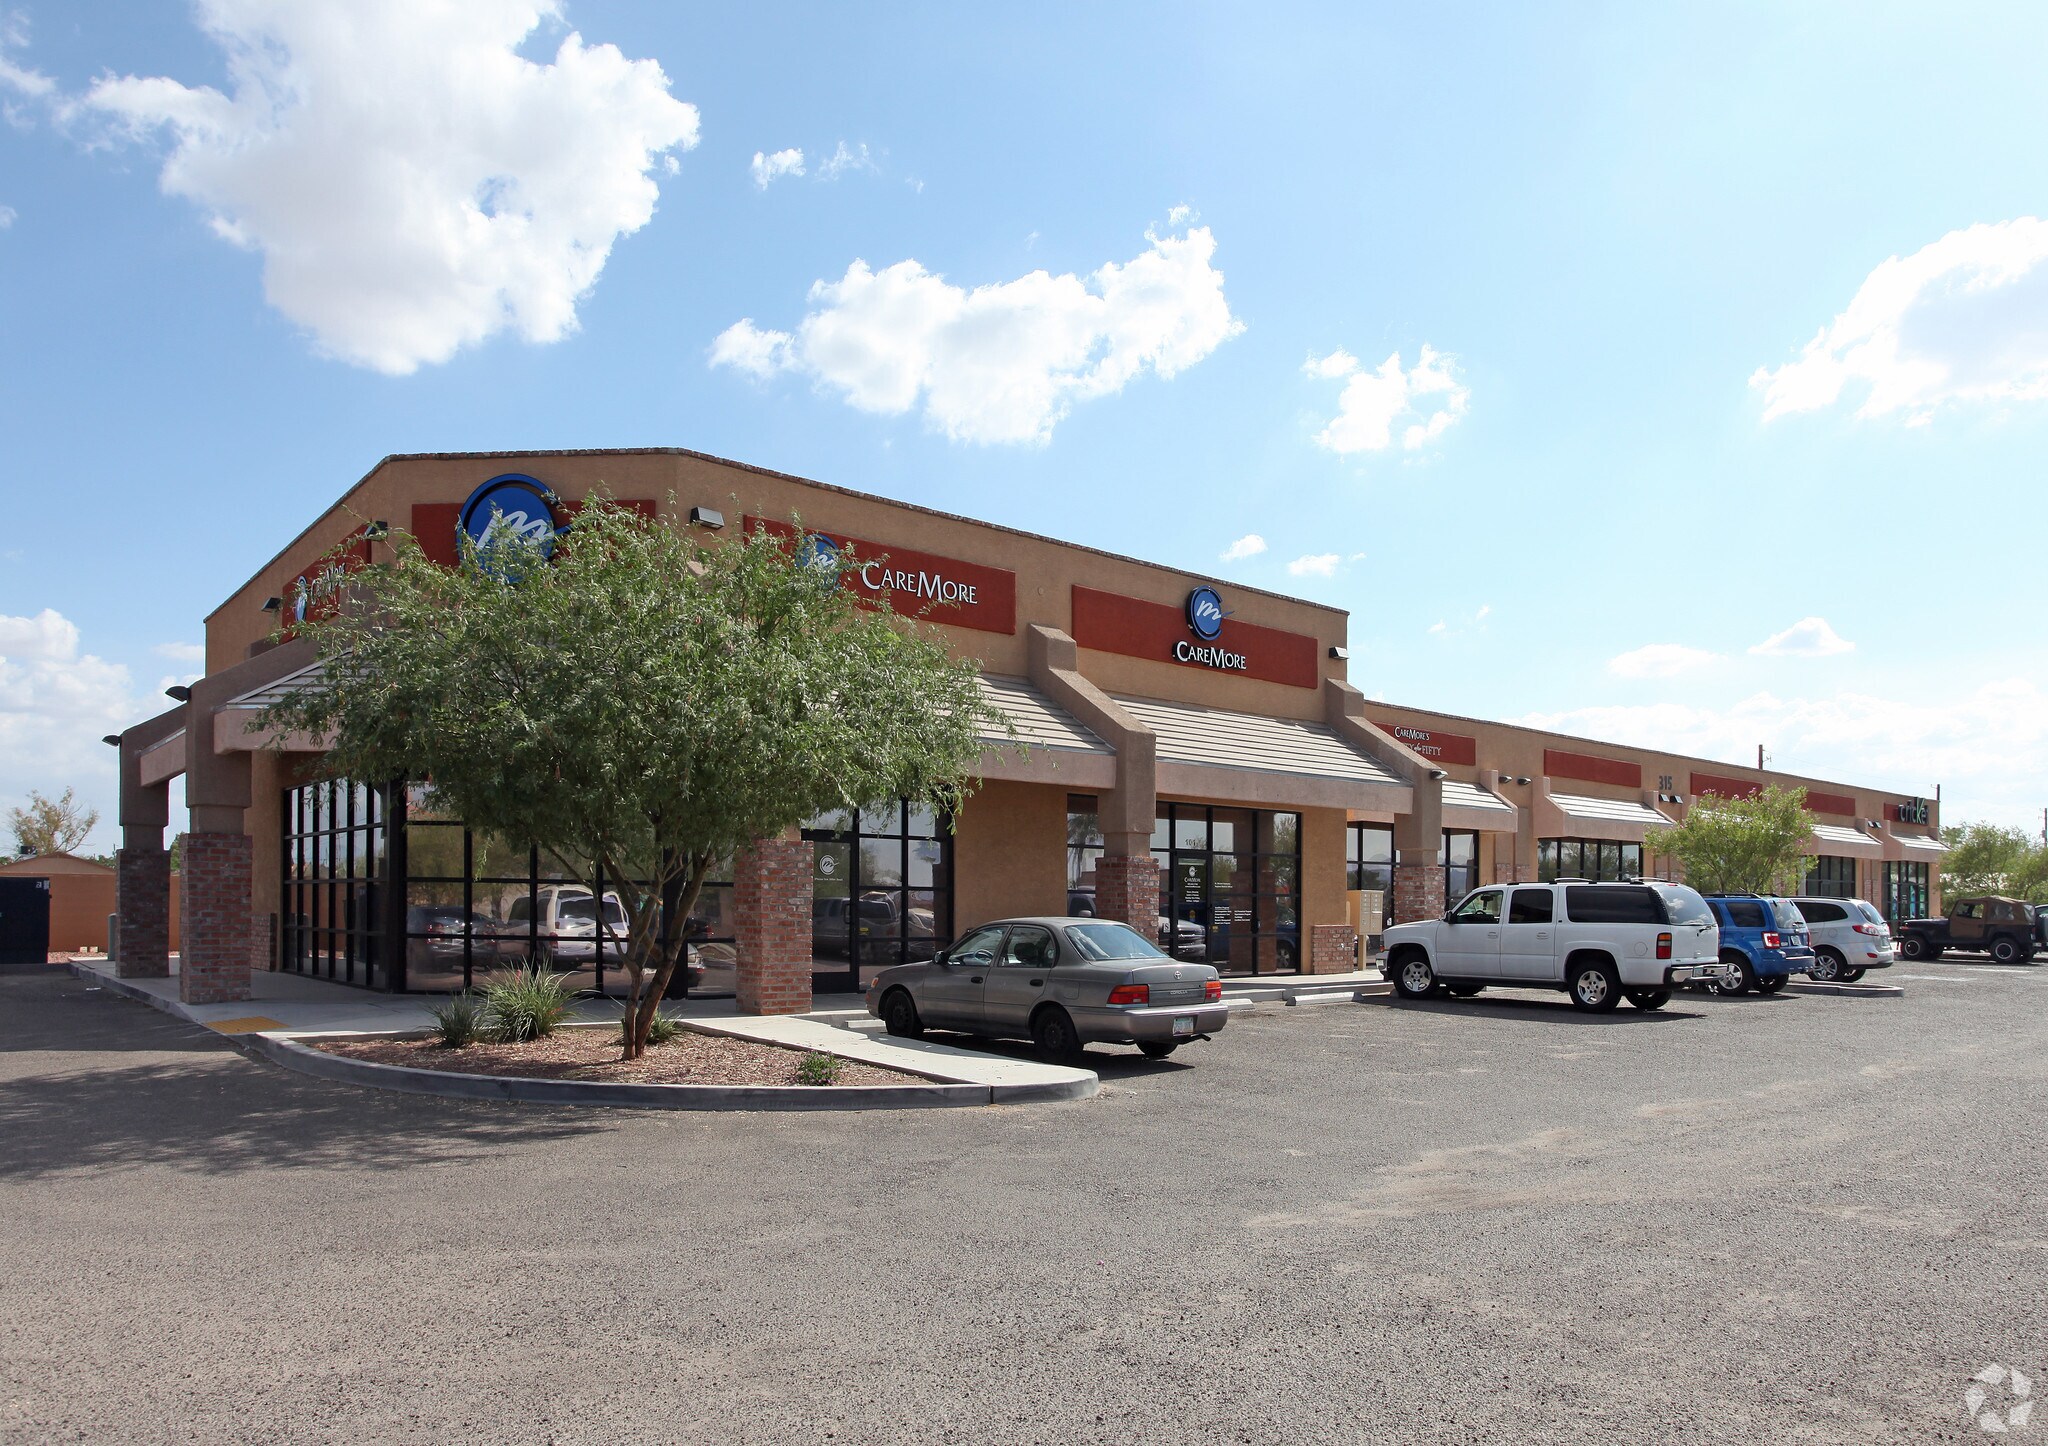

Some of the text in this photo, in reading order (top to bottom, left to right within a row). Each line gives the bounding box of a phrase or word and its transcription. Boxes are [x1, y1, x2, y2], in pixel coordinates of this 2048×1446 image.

[861, 560, 978, 604] CAREMORE
[1176, 640, 1247, 670] CAREMORE
[1421, 745, 1442, 756] FIFTY
[1658, 775, 1673, 791] 315
